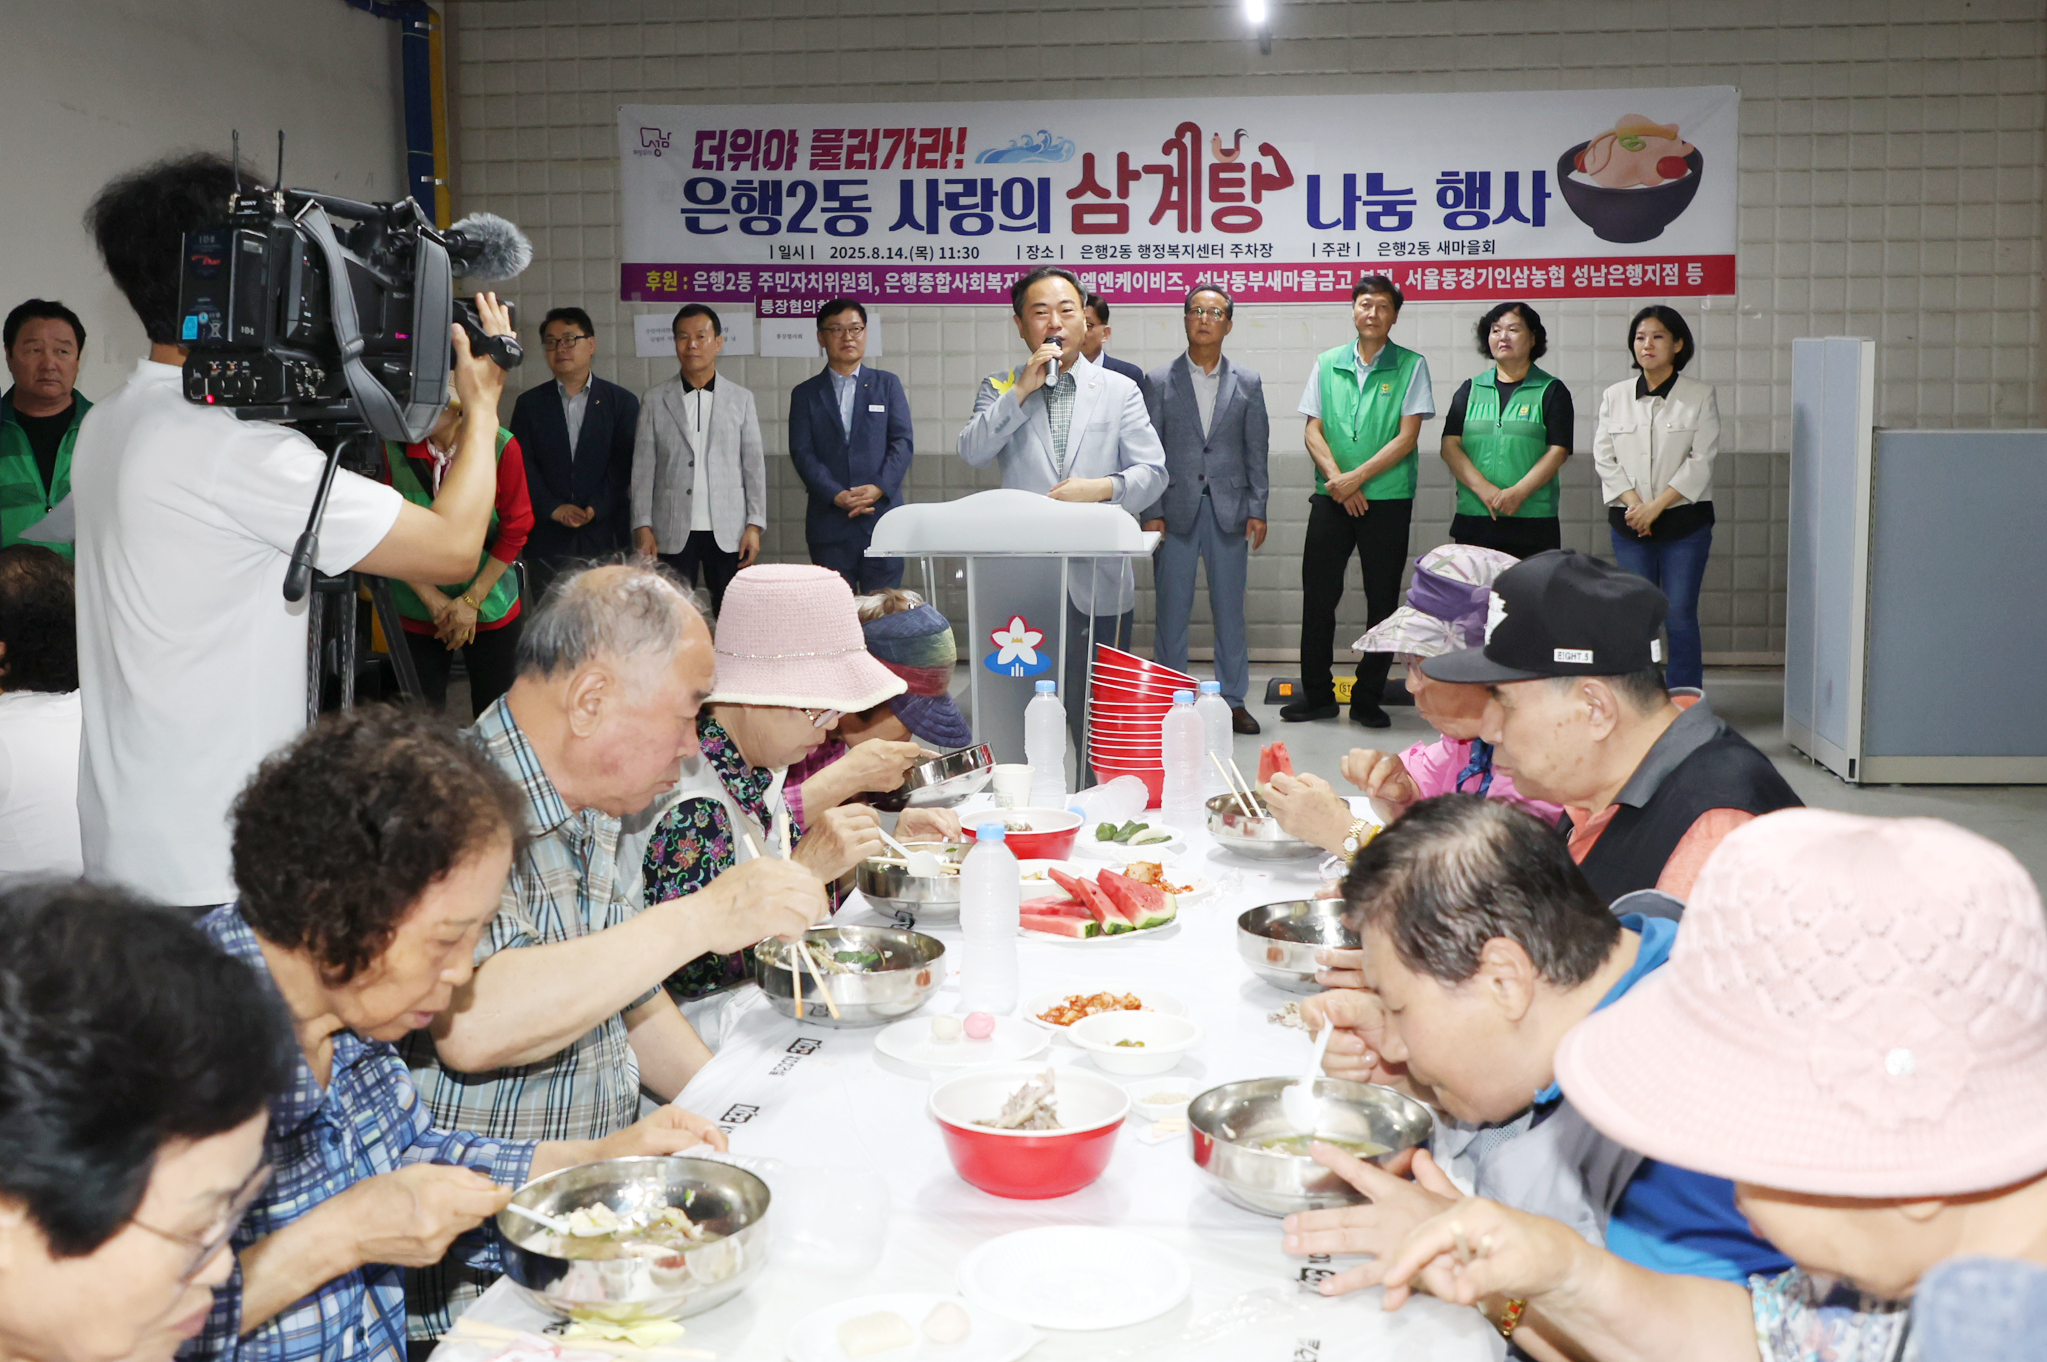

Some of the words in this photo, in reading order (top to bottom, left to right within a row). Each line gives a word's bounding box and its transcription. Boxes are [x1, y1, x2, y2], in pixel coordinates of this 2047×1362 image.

[692, 129, 799, 171] 더위야
[809, 127, 967, 171] 물러가라!
[681, 177, 872, 236] 은행2동
[889, 177, 1051, 236] 사랑의
[1066, 121, 1294, 234] 삼계탕
[1307, 172, 1417, 232] 나눔
[1436, 170, 1551, 231] 행사
[779, 245, 805, 260] 일시
[830, 246, 934, 262] 2025.8.14.(목)
[939, 246, 980, 260] 11:30
[1026, 245, 1055, 260] 장소
[1080, 244, 1132, 259] 은행2동
[1138, 243, 1224, 260] 행정복지센터
[1230, 243, 1273, 258] 주차장
[1322, 242, 1350, 257] 주관
[1377, 241, 1431, 256] 은행2동
[1436, 239, 1495, 256] 새마을회
[646, 271, 678, 292] 후원
[693, 271, 752, 292] 은행2동
[758, 272, 880, 295] 주민자치위원회,
[884, 271, 1028, 293] 은행종합사회복지
[1405, 265, 1565, 290] 서울동경기인삼농협
[1572, 263, 1679, 287] 성남은행지점
[1686, 263, 1704, 285] 등
